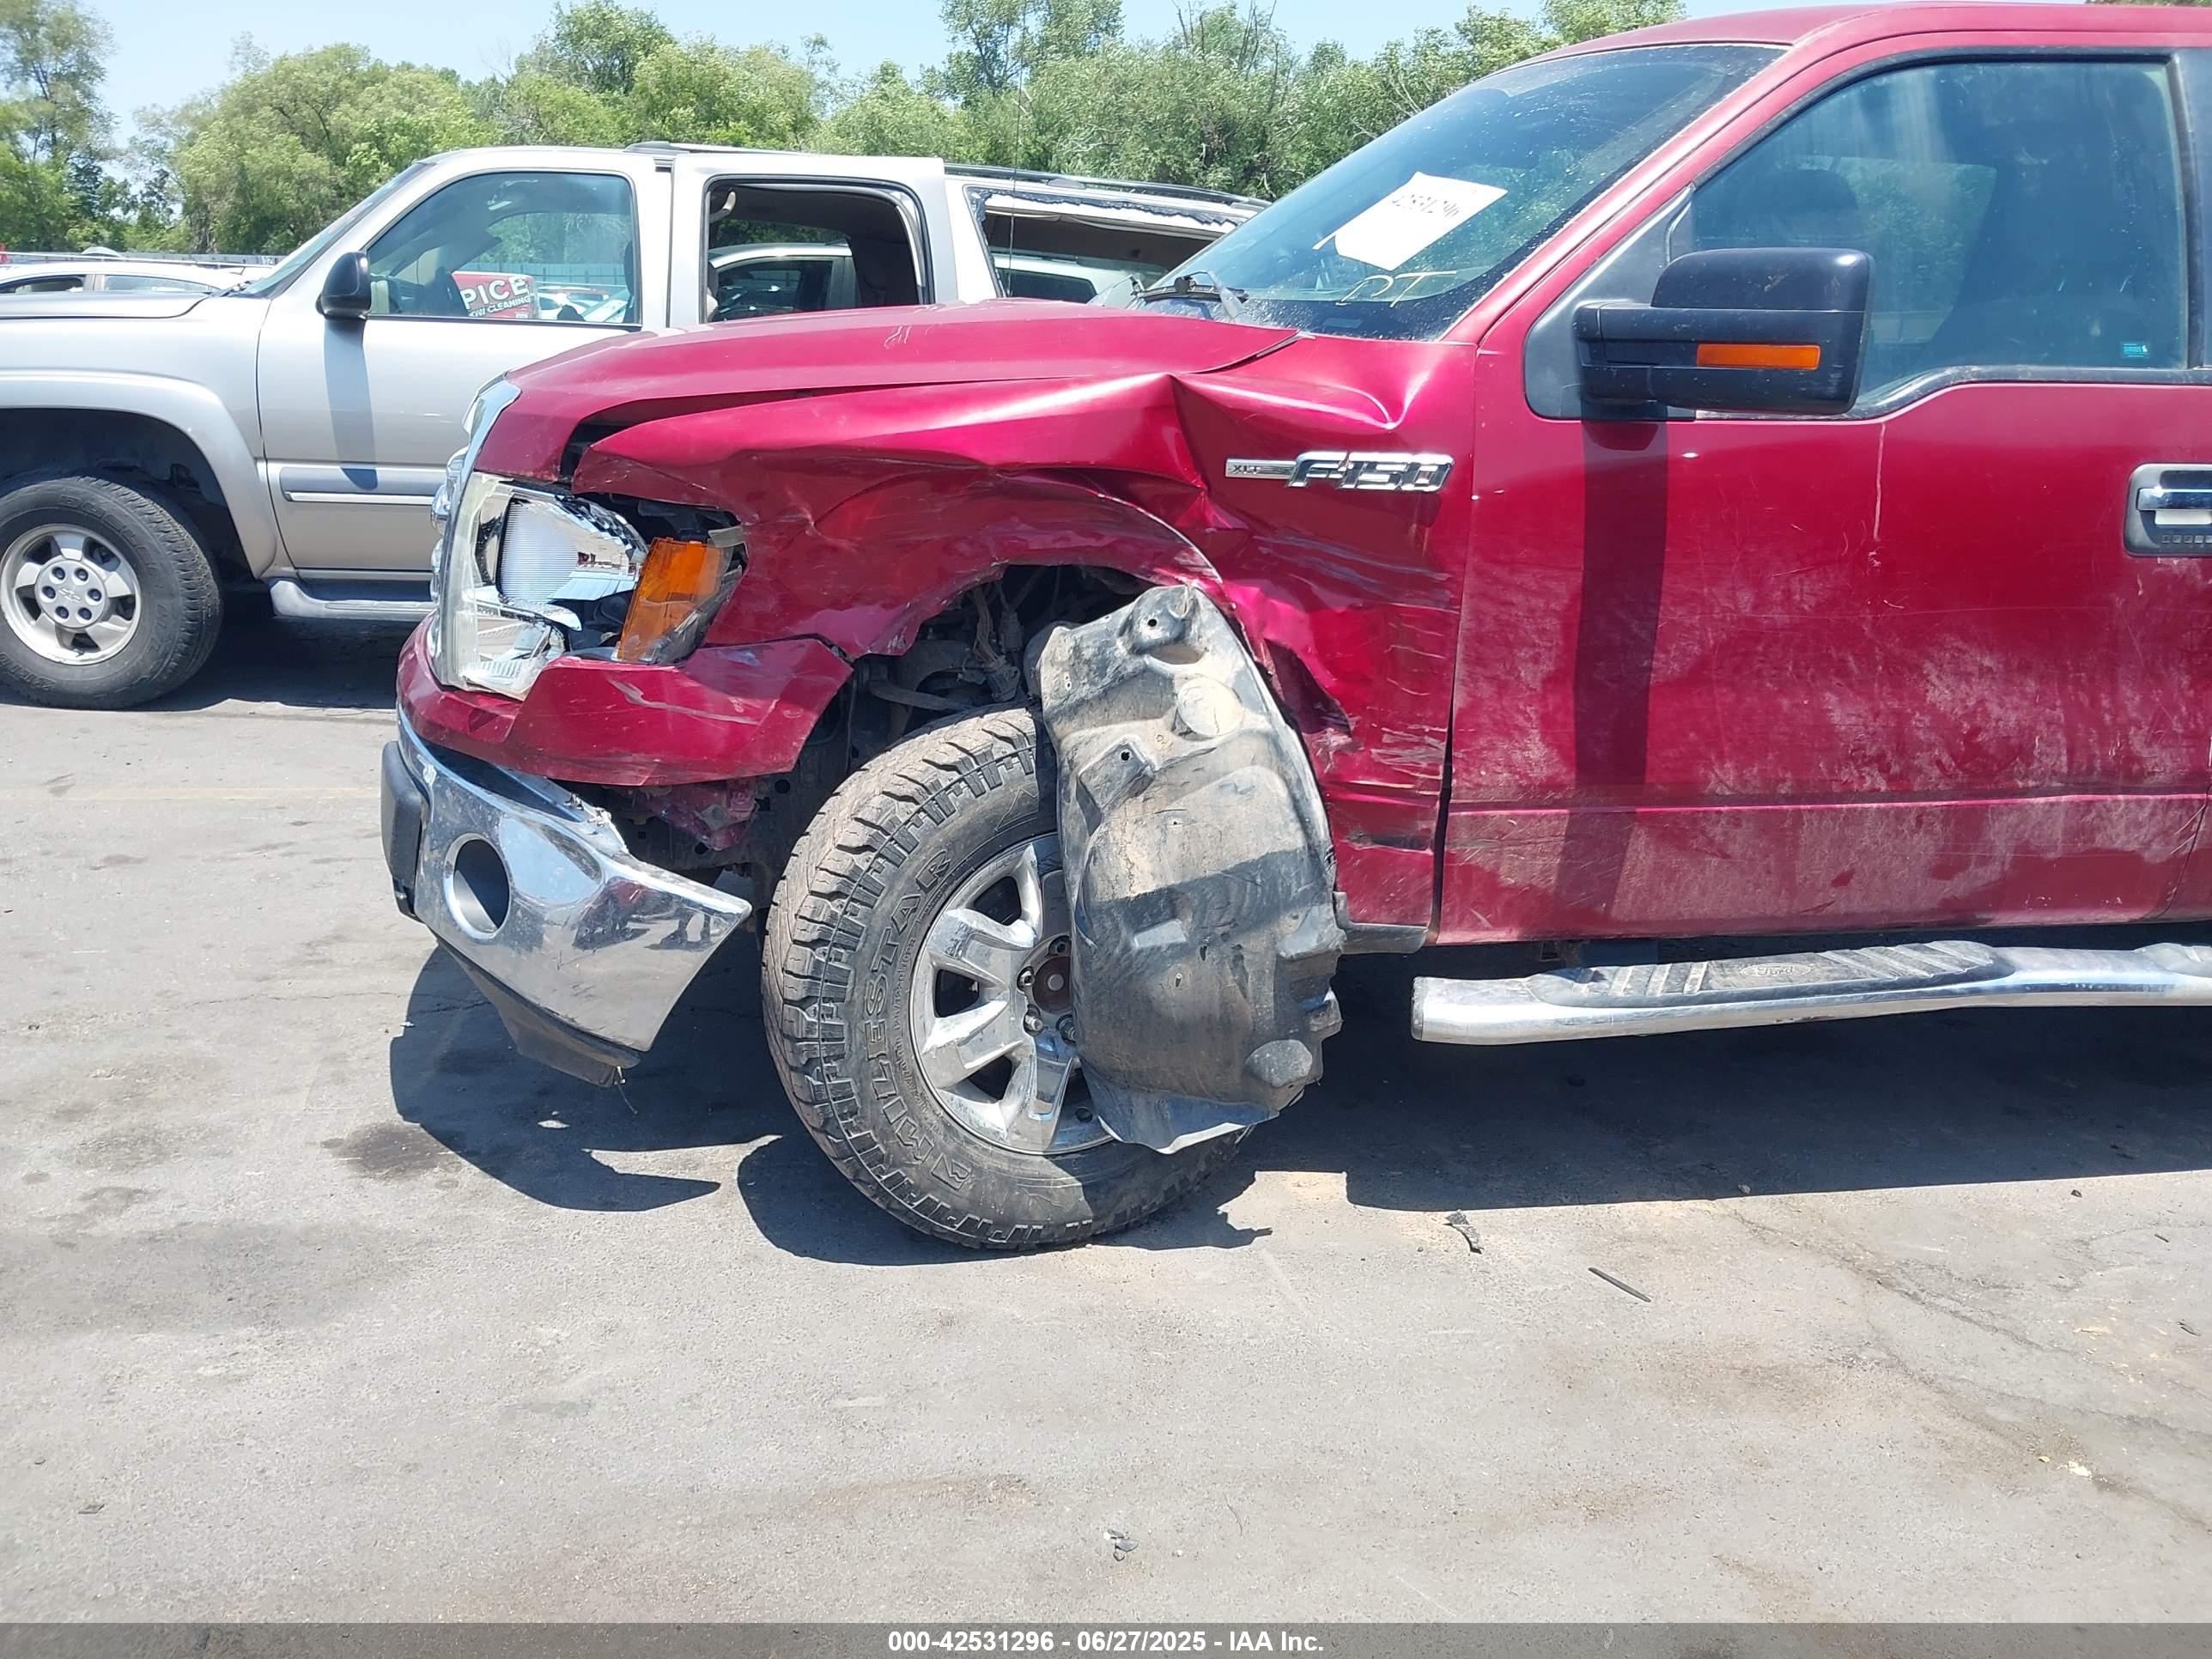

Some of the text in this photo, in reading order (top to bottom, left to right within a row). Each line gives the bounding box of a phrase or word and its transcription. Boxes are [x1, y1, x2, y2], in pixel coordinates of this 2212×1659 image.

[487, 295, 531, 313] CLEANING
[1231, 465, 1260, 475] XLT
[1757, 964, 1794, 976] Ford
[864, 849, 951, 1163] MILESTAR
